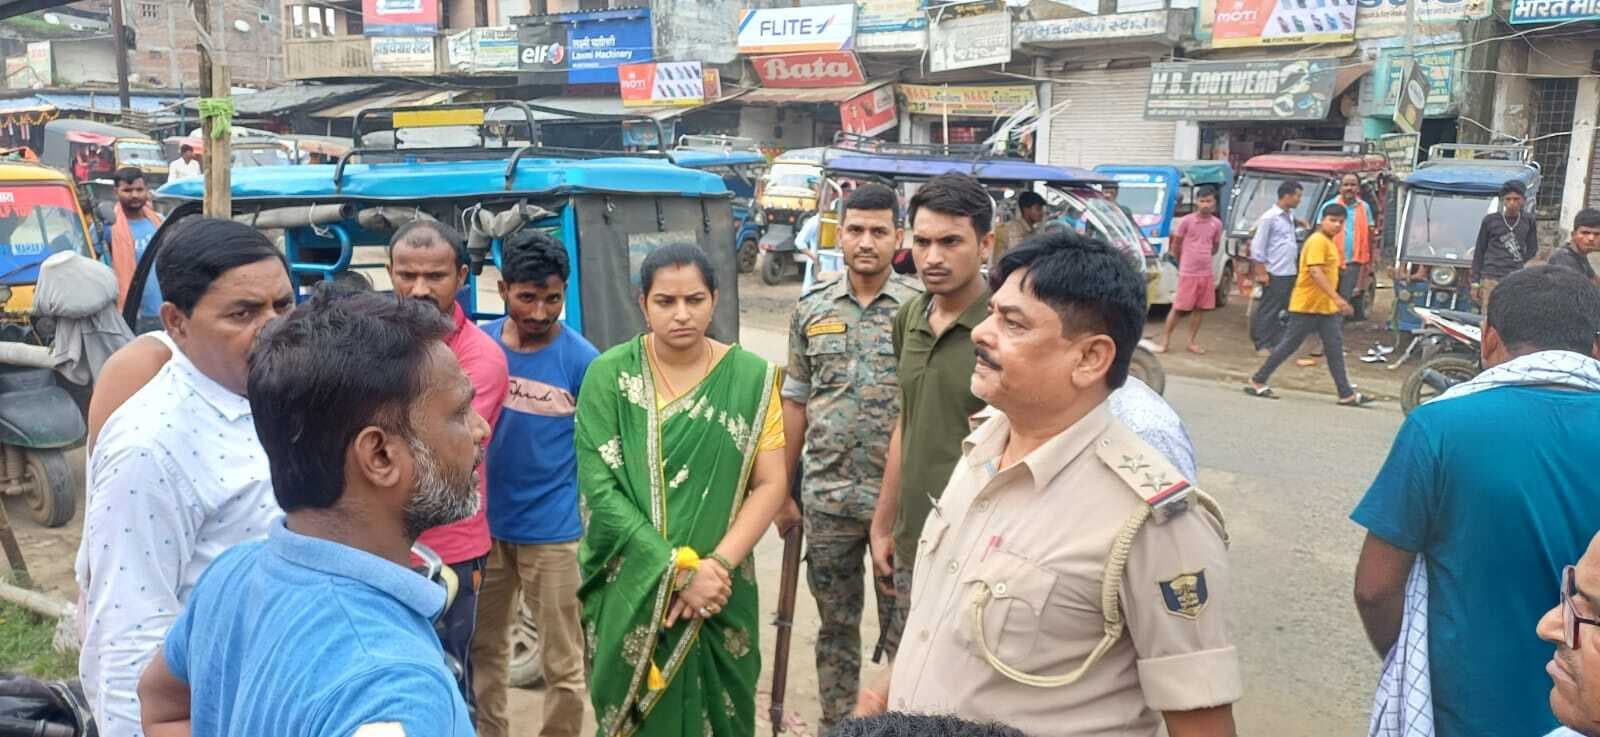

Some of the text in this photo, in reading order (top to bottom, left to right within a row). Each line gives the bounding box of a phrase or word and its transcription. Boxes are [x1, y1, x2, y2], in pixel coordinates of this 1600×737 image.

[1515, 0, 1568, 17] भारत
[760, 18, 813, 36] FLITE
[521, 45, 548, 64] elf
[572, 48, 633, 61] Laxmi Machinery
[763, 56, 853, 81] Bata
[1150, 69, 1281, 95] M.B. FOOTWEAR
